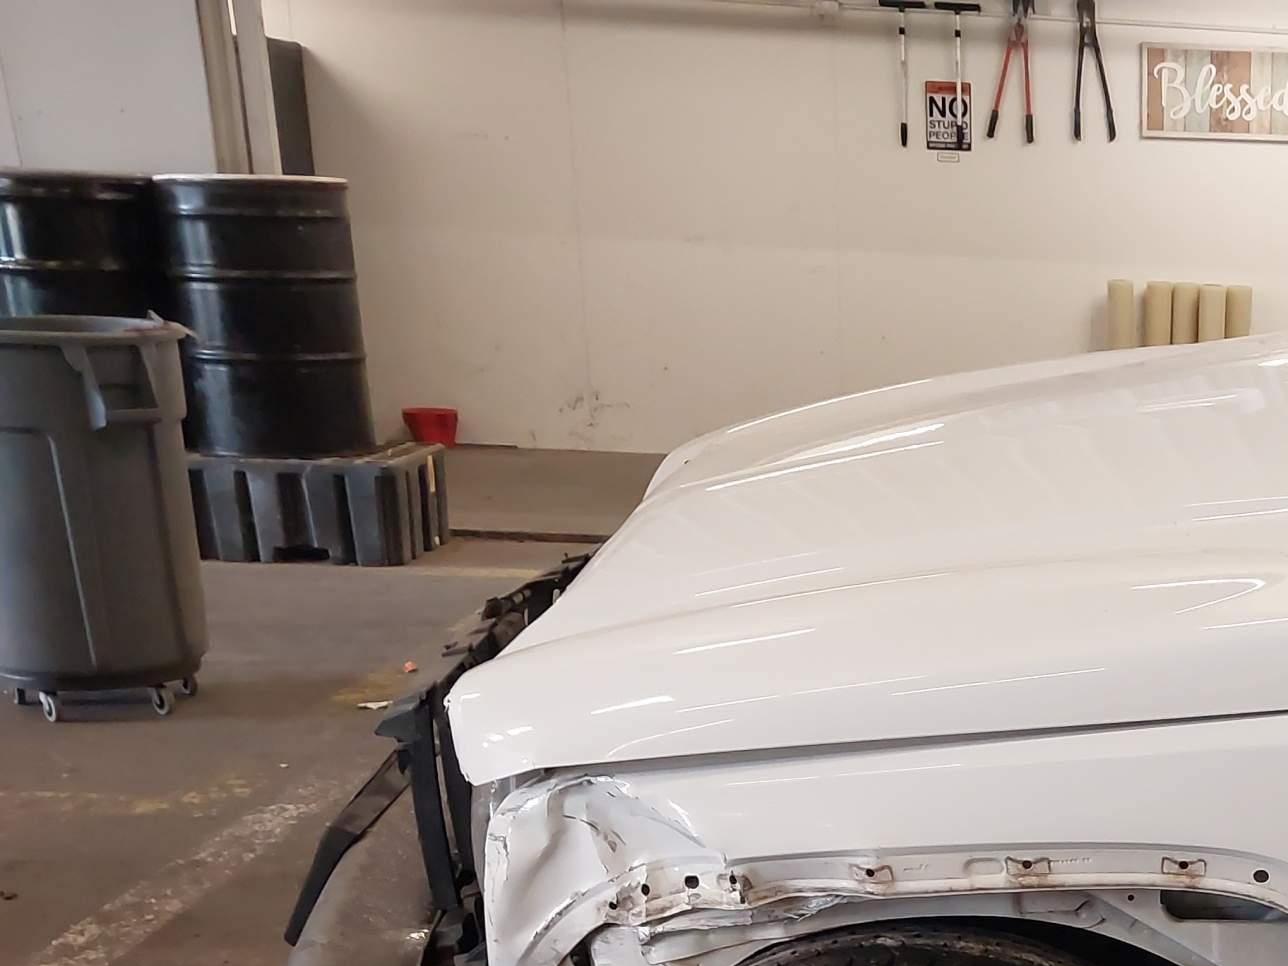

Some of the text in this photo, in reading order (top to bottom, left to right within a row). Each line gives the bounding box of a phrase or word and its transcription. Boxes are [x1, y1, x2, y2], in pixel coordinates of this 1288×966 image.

[928, 95, 968, 119] NO
[928, 119, 968, 130] STUPD
[928, 131, 968, 141] PEOPE
